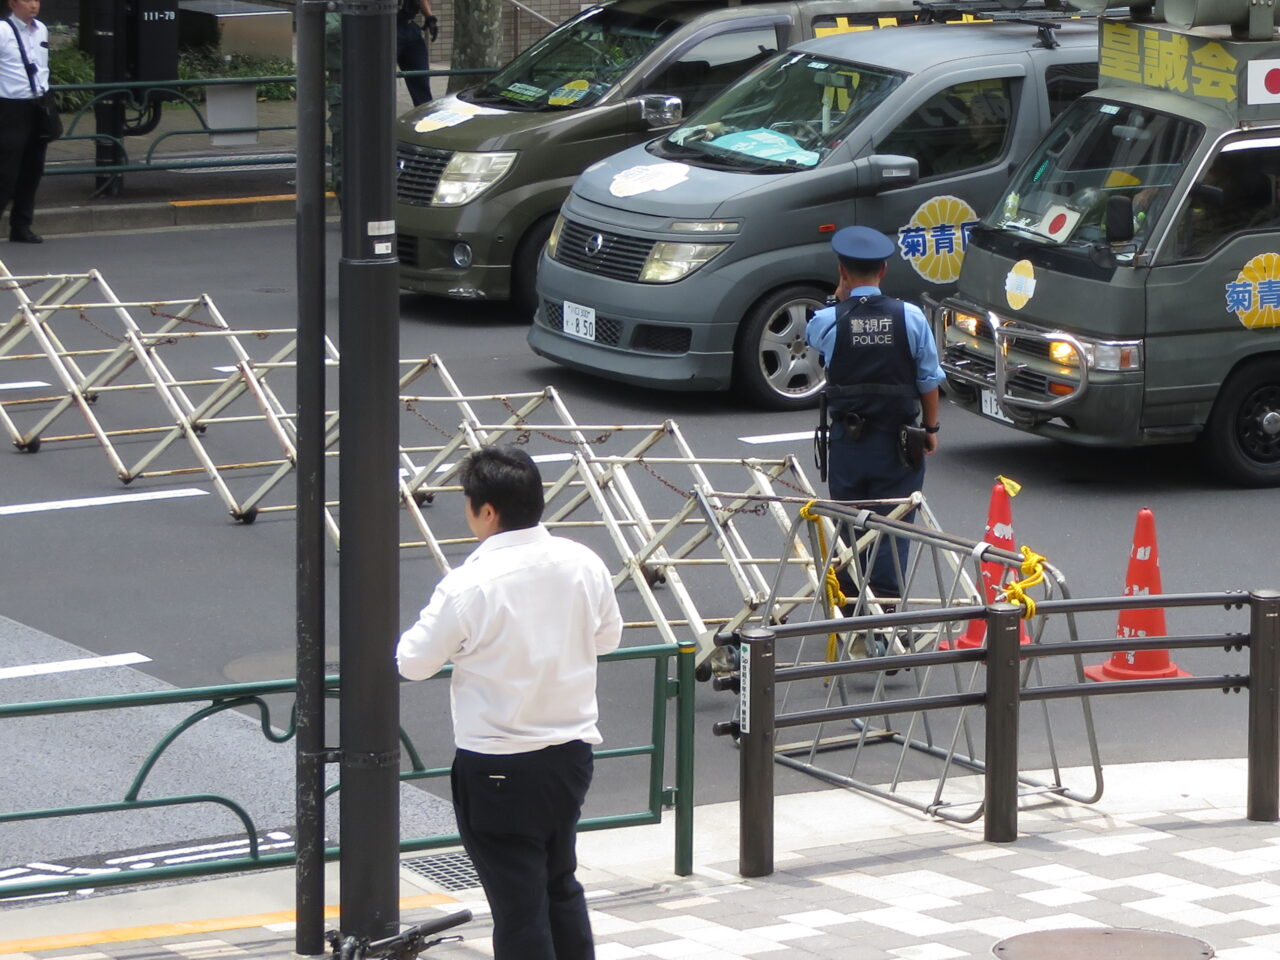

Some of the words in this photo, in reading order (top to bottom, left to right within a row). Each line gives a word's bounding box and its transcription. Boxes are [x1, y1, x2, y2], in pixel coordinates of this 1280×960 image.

[144, 11, 176, 21] 111-79
[1099, 22, 1238, 103] 皇誠会
[851, 318, 893, 334] 警視庁
[852, 334, 892, 345] POLICE
